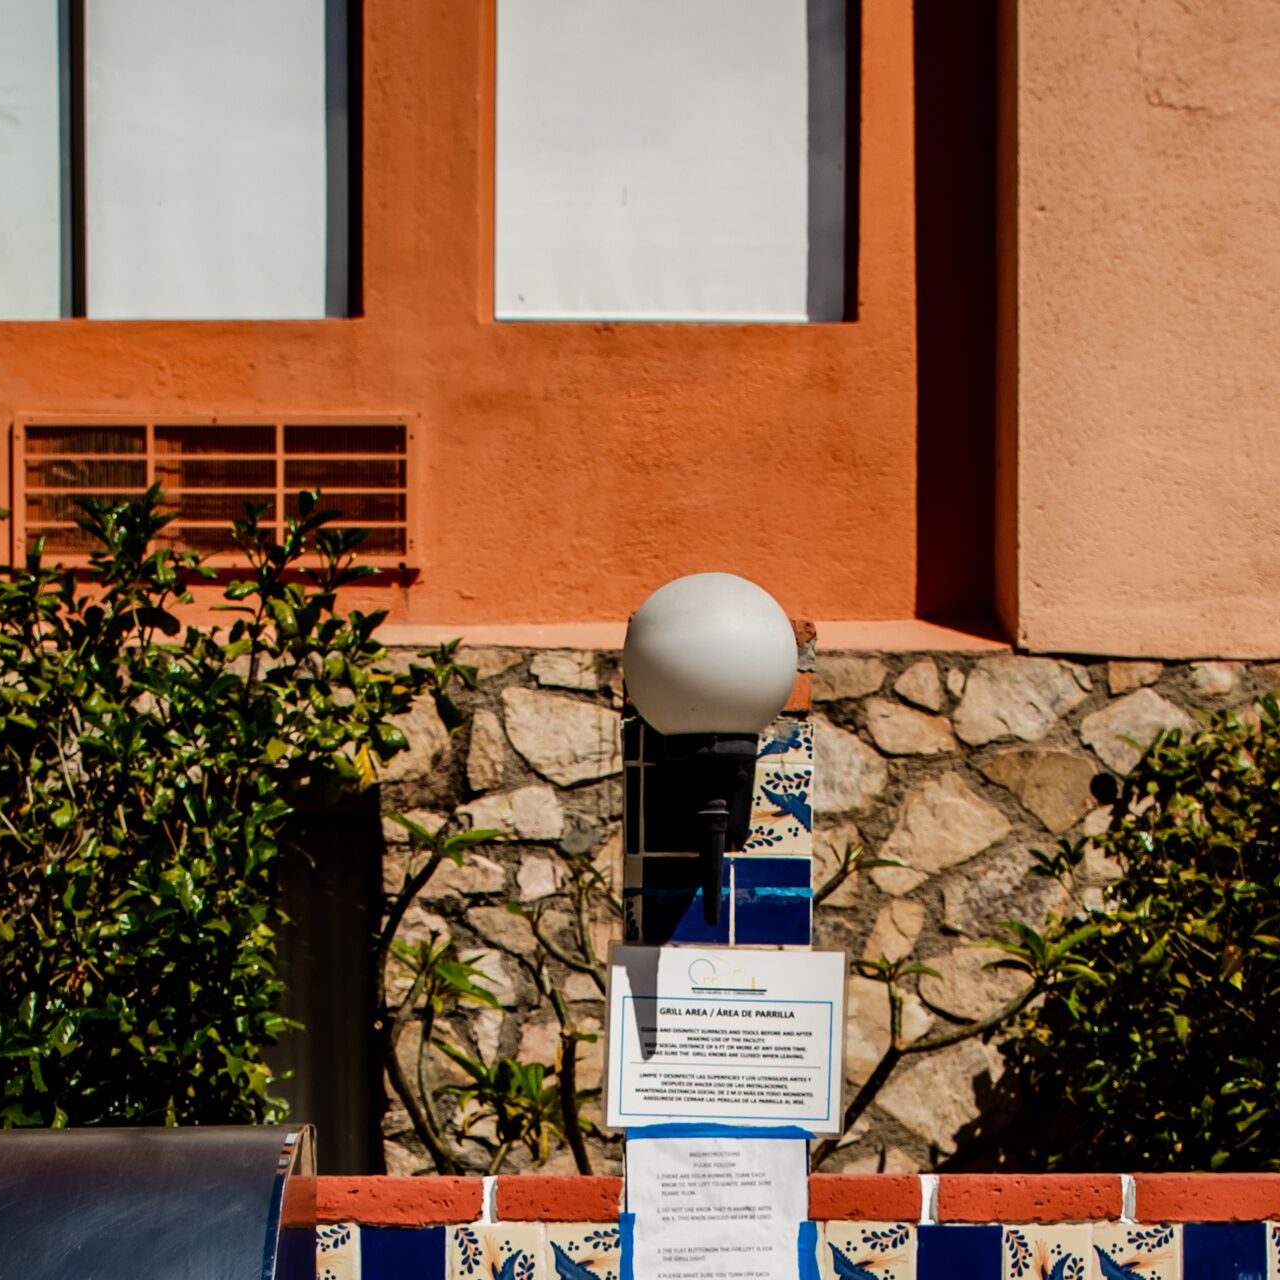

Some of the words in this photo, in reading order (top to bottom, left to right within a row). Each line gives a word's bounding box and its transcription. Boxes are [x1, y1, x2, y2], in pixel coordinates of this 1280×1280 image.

[660, 1008, 683, 1016] GRILL
[685, 1008, 708, 1017] AREA
[717, 1008, 739, 1017] ÁREA
[741, 1010, 753, 1018] DE
[755, 1010, 795, 1018] PARRILLA
